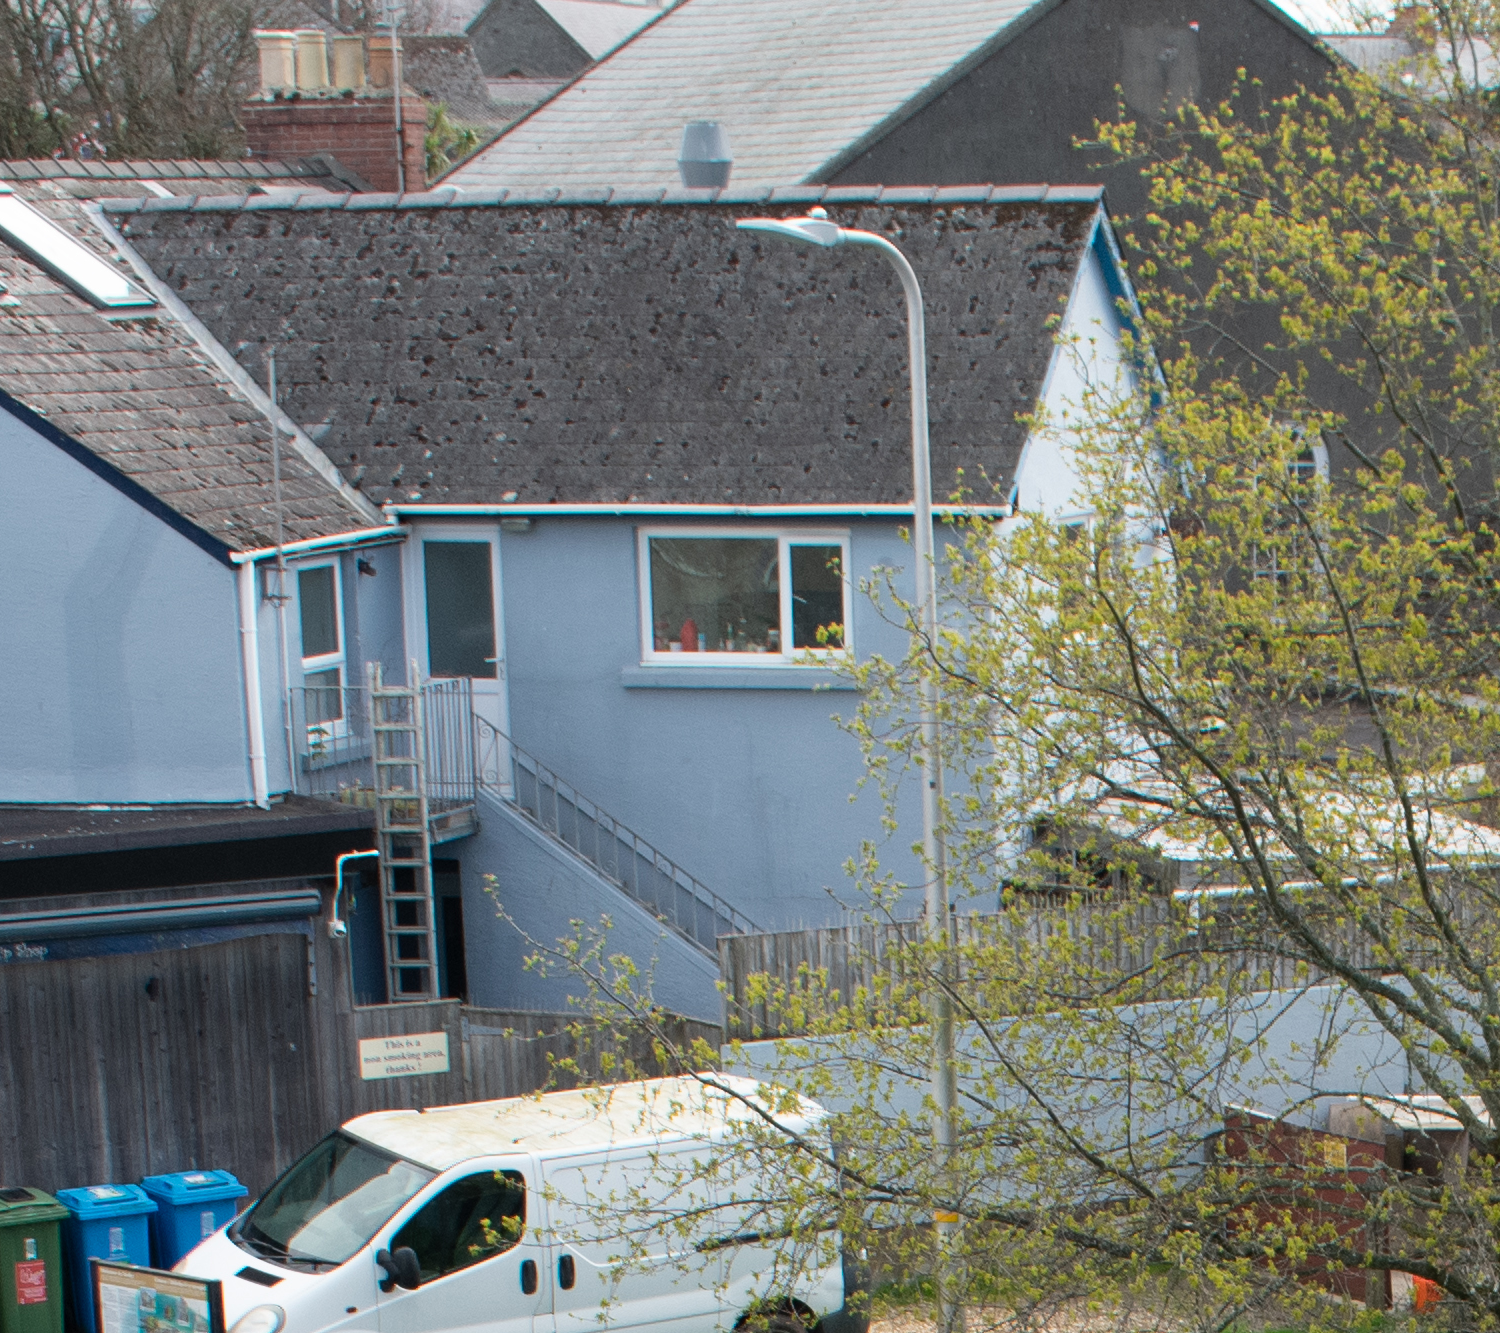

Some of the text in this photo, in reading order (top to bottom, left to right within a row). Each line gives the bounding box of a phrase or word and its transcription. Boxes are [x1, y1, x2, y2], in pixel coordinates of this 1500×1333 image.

[13, 942, 49, 961] Shop
[384, 1039, 404, 1050] This
[405, 1038, 414, 1048] is
[383, 1051, 422, 1062] smoking
[385, 1063, 416, 1074] thanks
